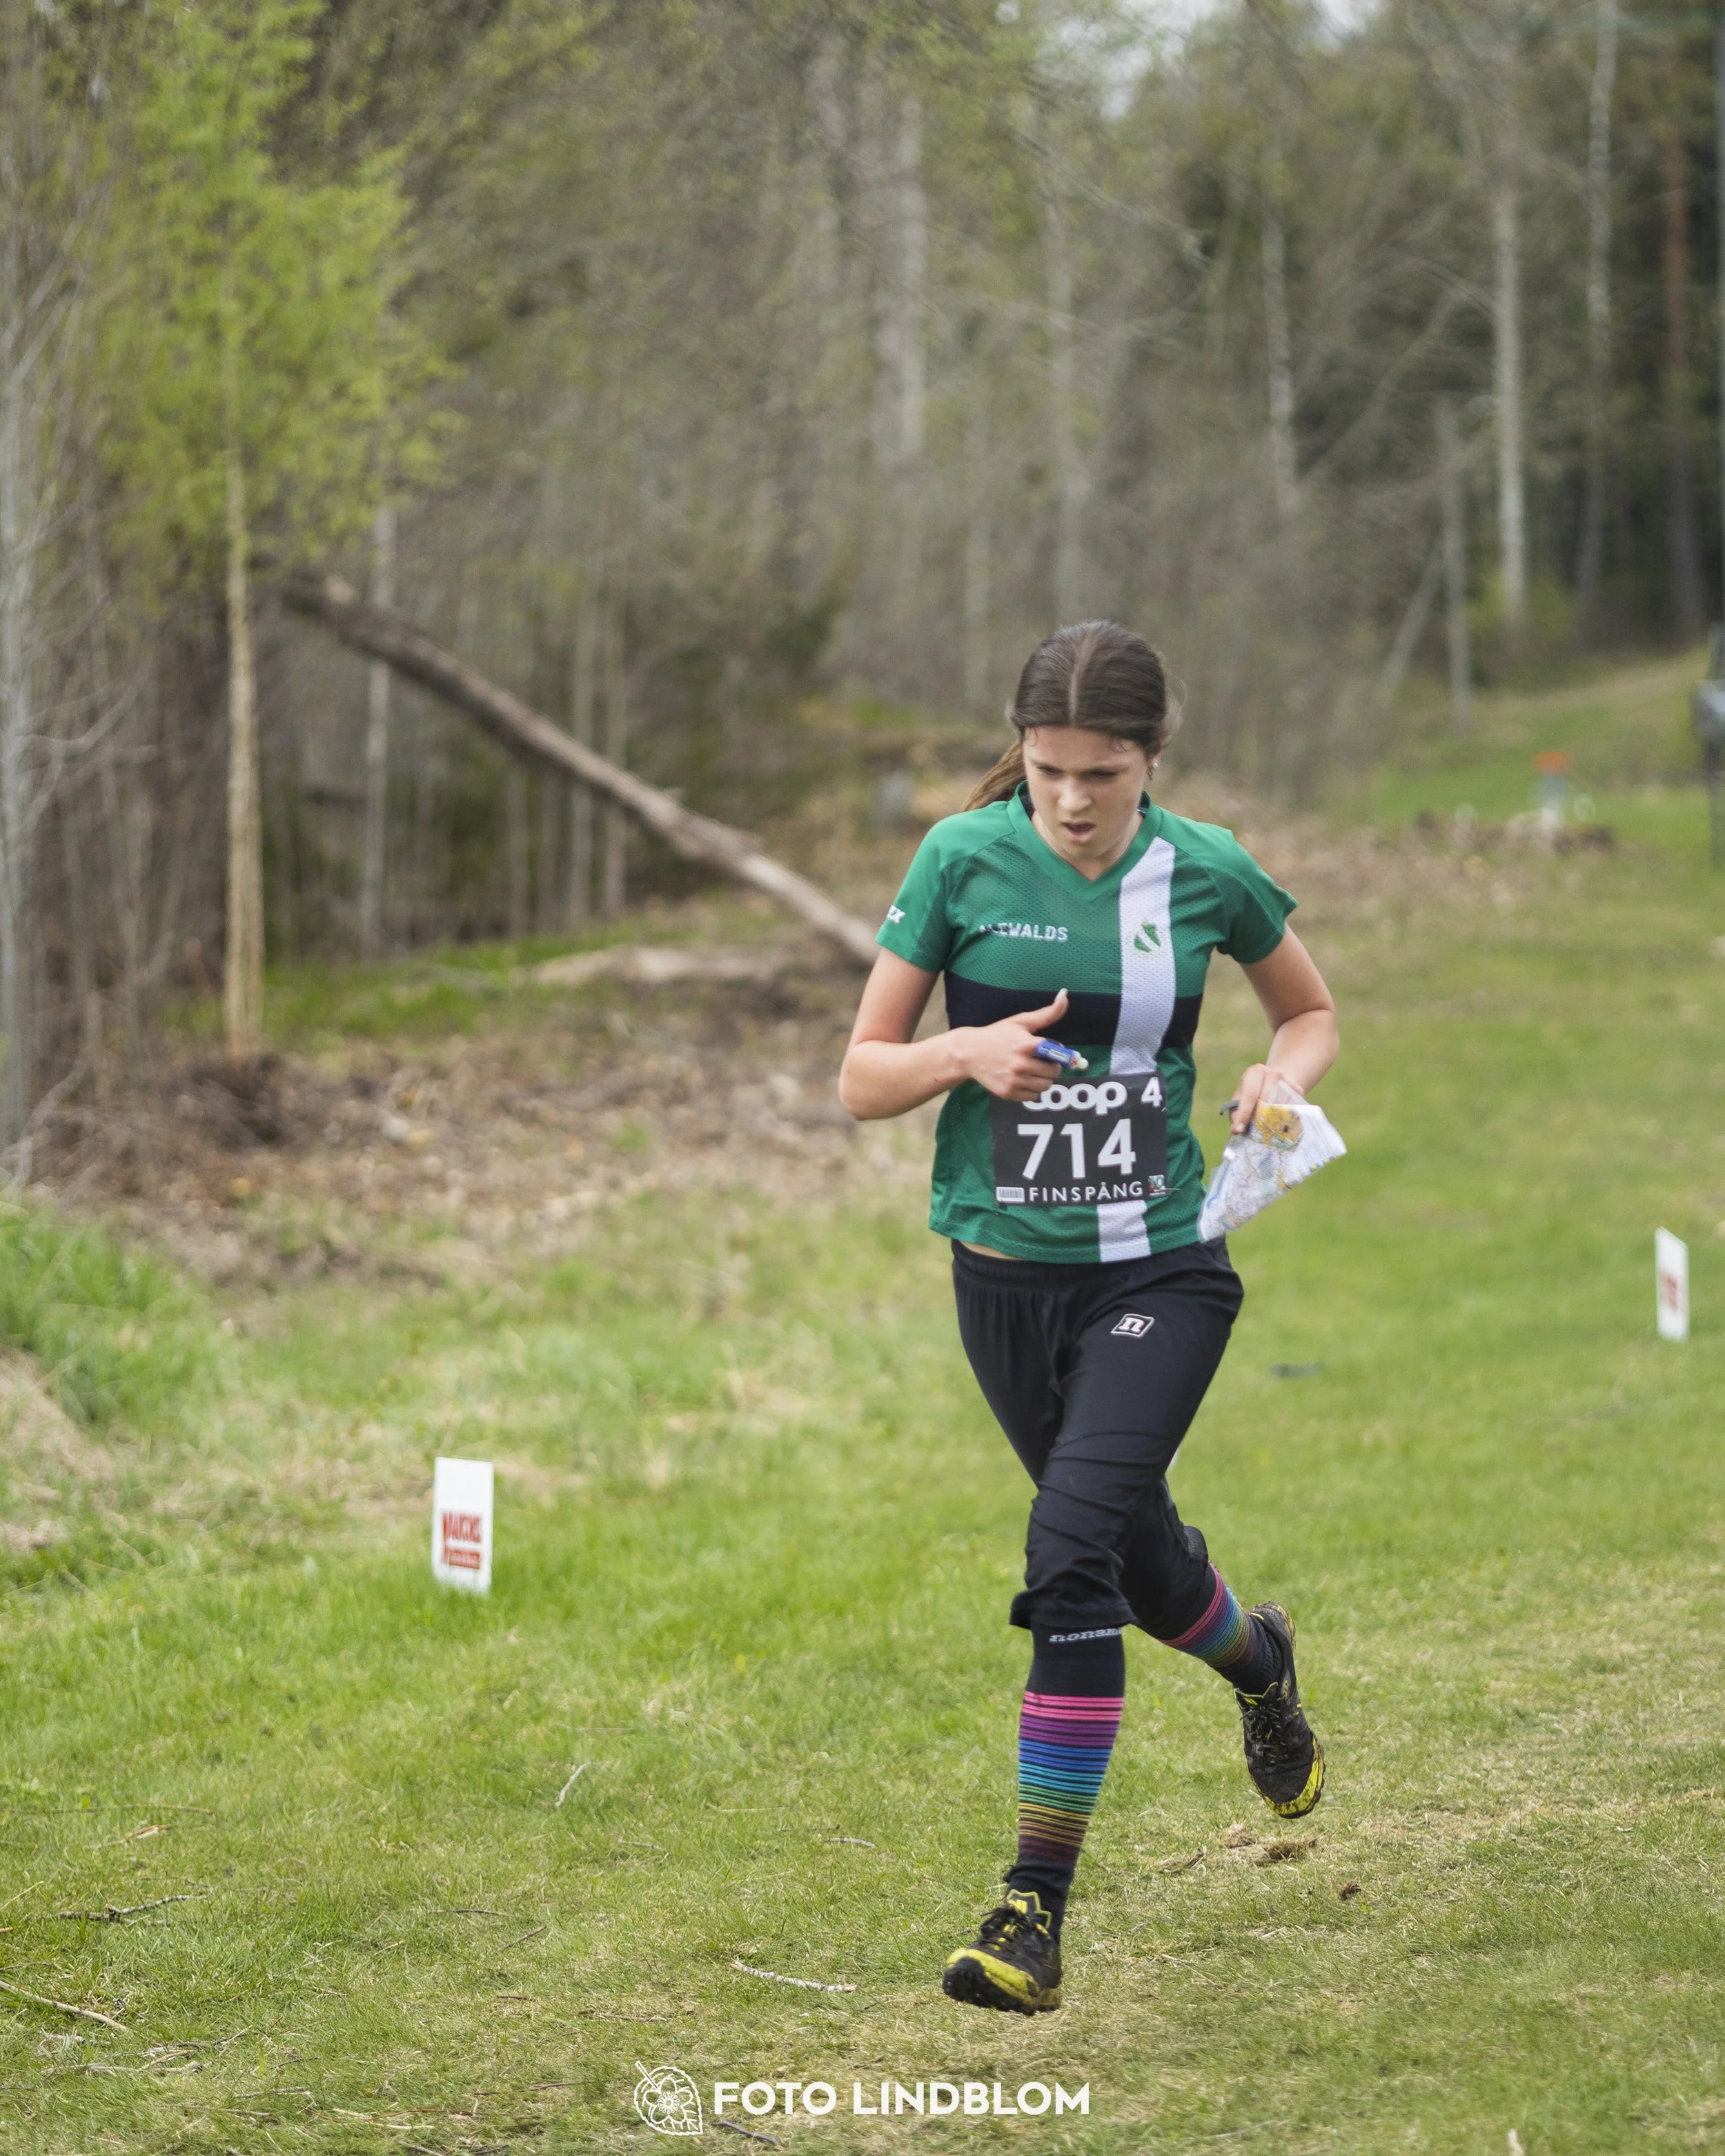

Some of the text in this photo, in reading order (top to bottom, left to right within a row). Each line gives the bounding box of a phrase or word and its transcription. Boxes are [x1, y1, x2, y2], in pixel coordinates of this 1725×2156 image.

[1141, 1076, 1163, 1107] 4
[1017, 1118, 1136, 1180] 714
[1029, 1180, 1143, 1203] FINSPÅNG
[1049, 1628, 1122, 1642] nonam
